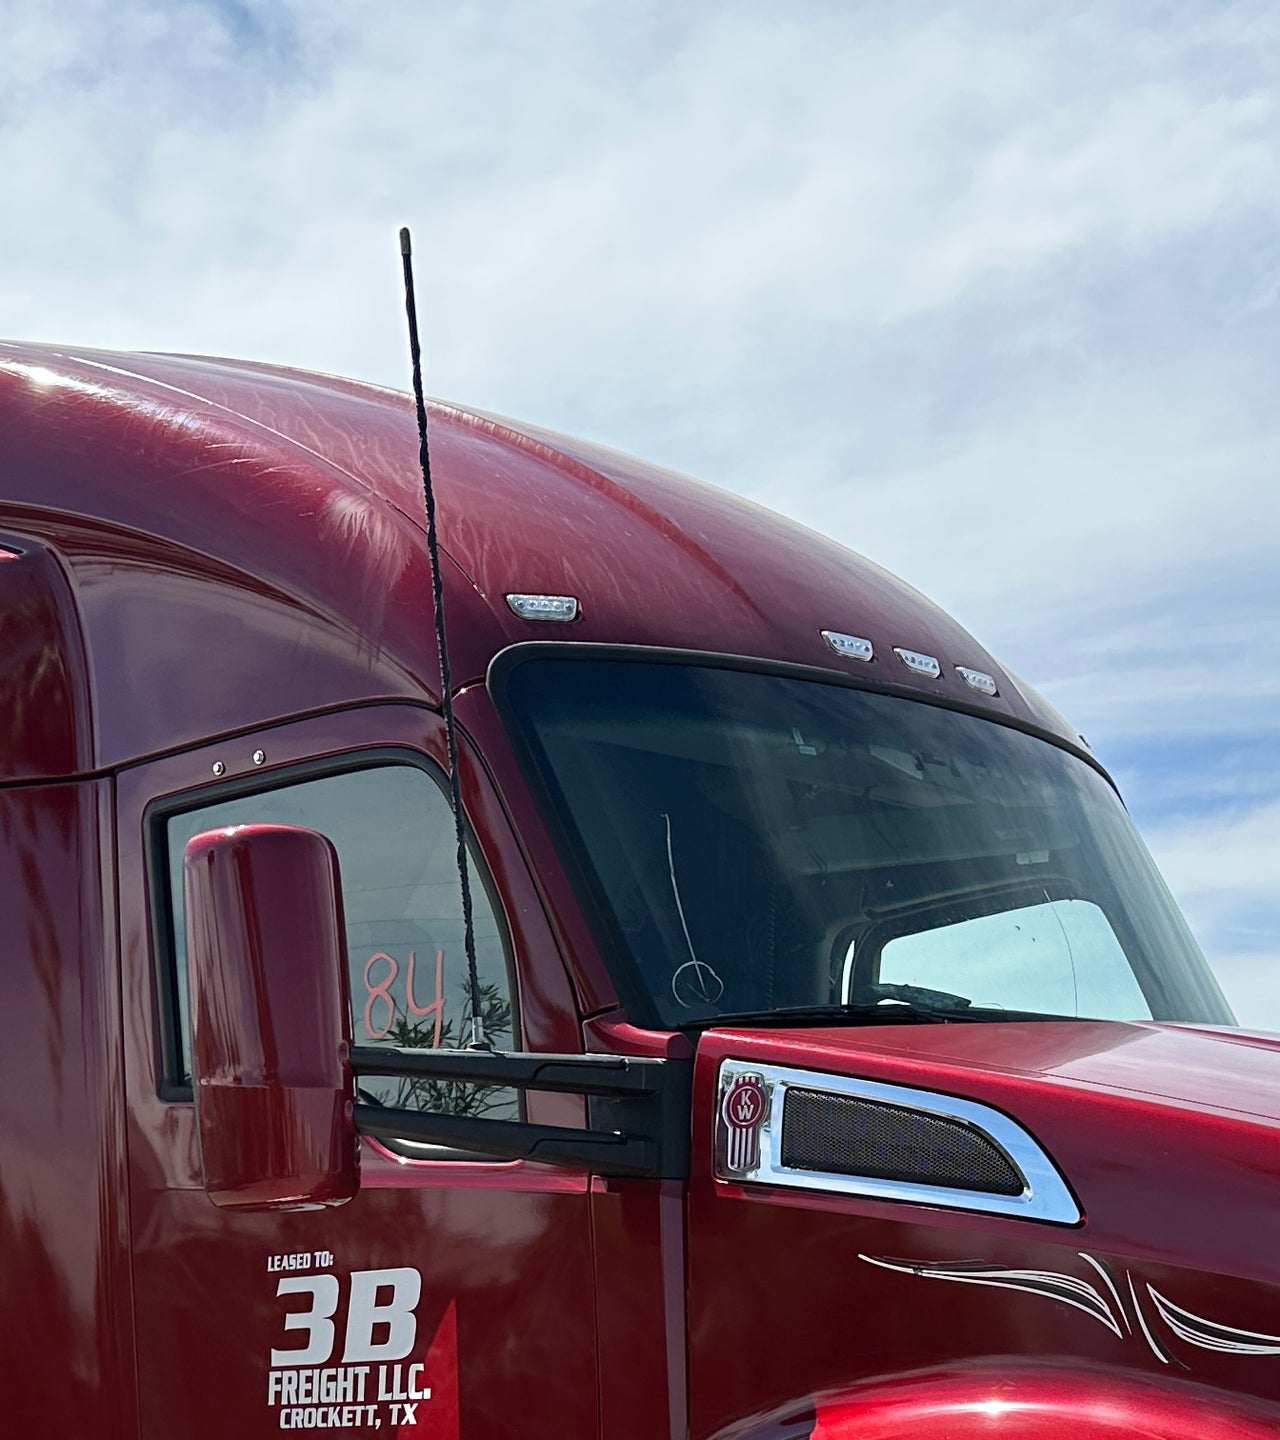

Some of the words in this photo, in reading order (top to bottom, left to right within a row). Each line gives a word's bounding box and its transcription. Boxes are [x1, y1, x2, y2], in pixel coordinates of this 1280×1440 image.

[363, 949, 445, 1049] 84
[267, 1252, 312, 1272] LEASED
[314, 1250, 335, 1268] TO:
[270, 1267, 422, 1367] 3B
[268, 1366, 370, 1406] FREIGHT
[377, 1363, 432, 1401] LLC.
[279, 1405, 382, 1430] CROCKETT,
[388, 1403, 419, 1426] TX
